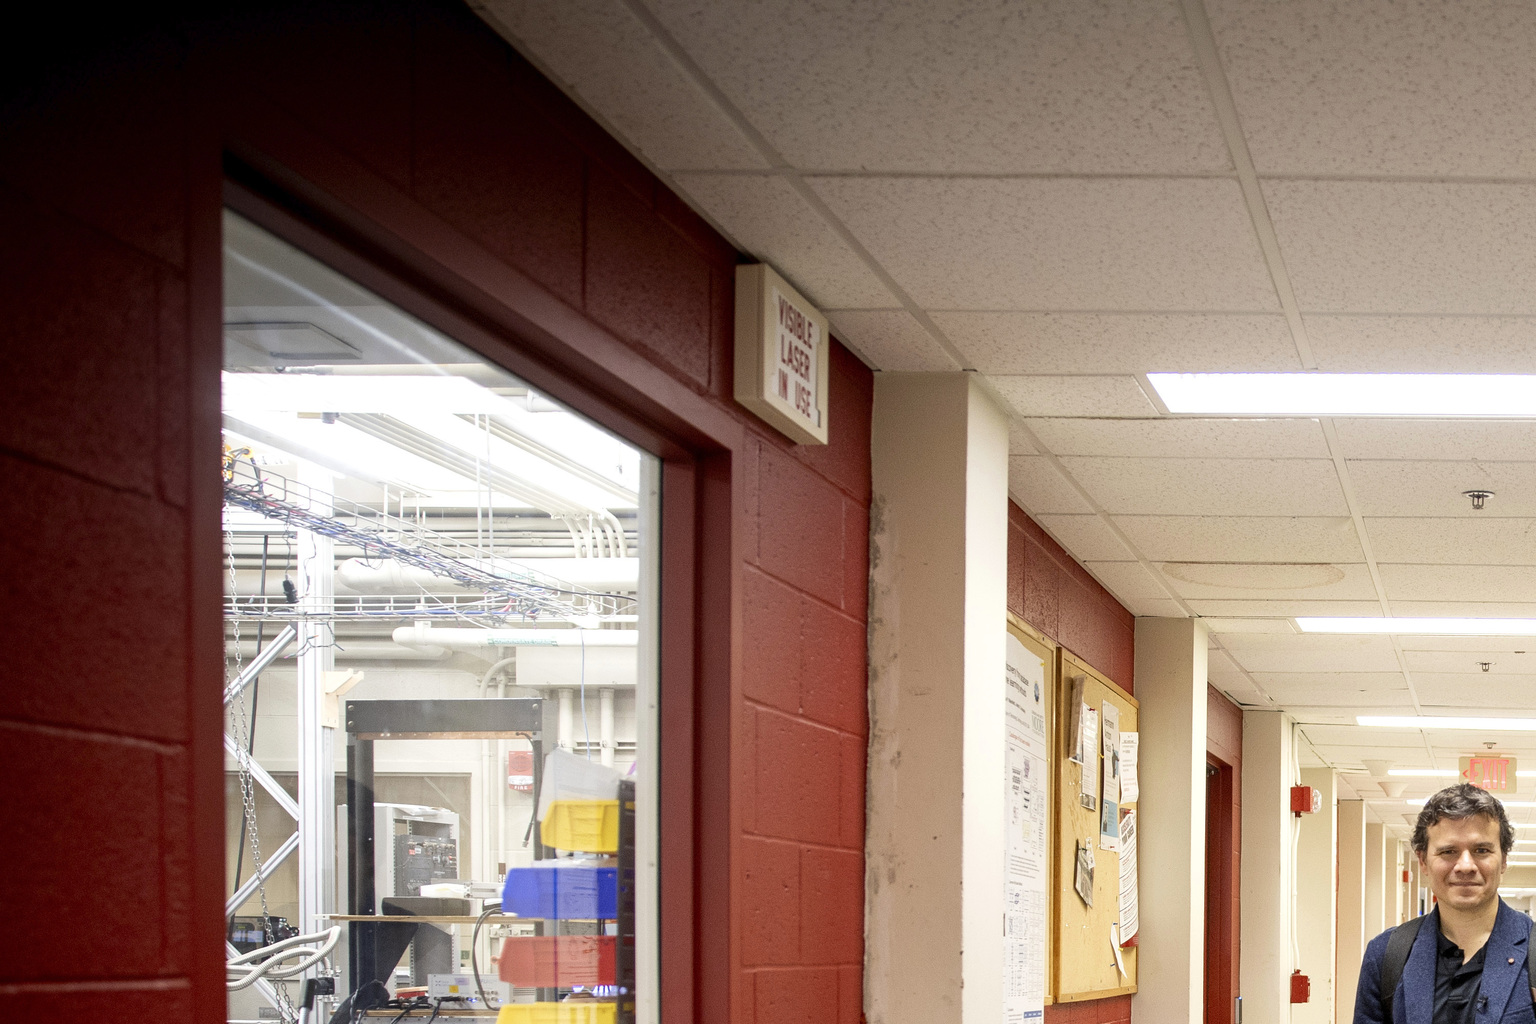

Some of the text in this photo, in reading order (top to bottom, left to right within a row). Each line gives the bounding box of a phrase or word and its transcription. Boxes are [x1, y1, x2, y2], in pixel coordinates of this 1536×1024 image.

[777, 295, 814, 350] VISIBLE
[780, 334, 811, 383] LASER
[778, 369, 812, 418] IN USE
[1469, 758, 1510, 790] EXIT
